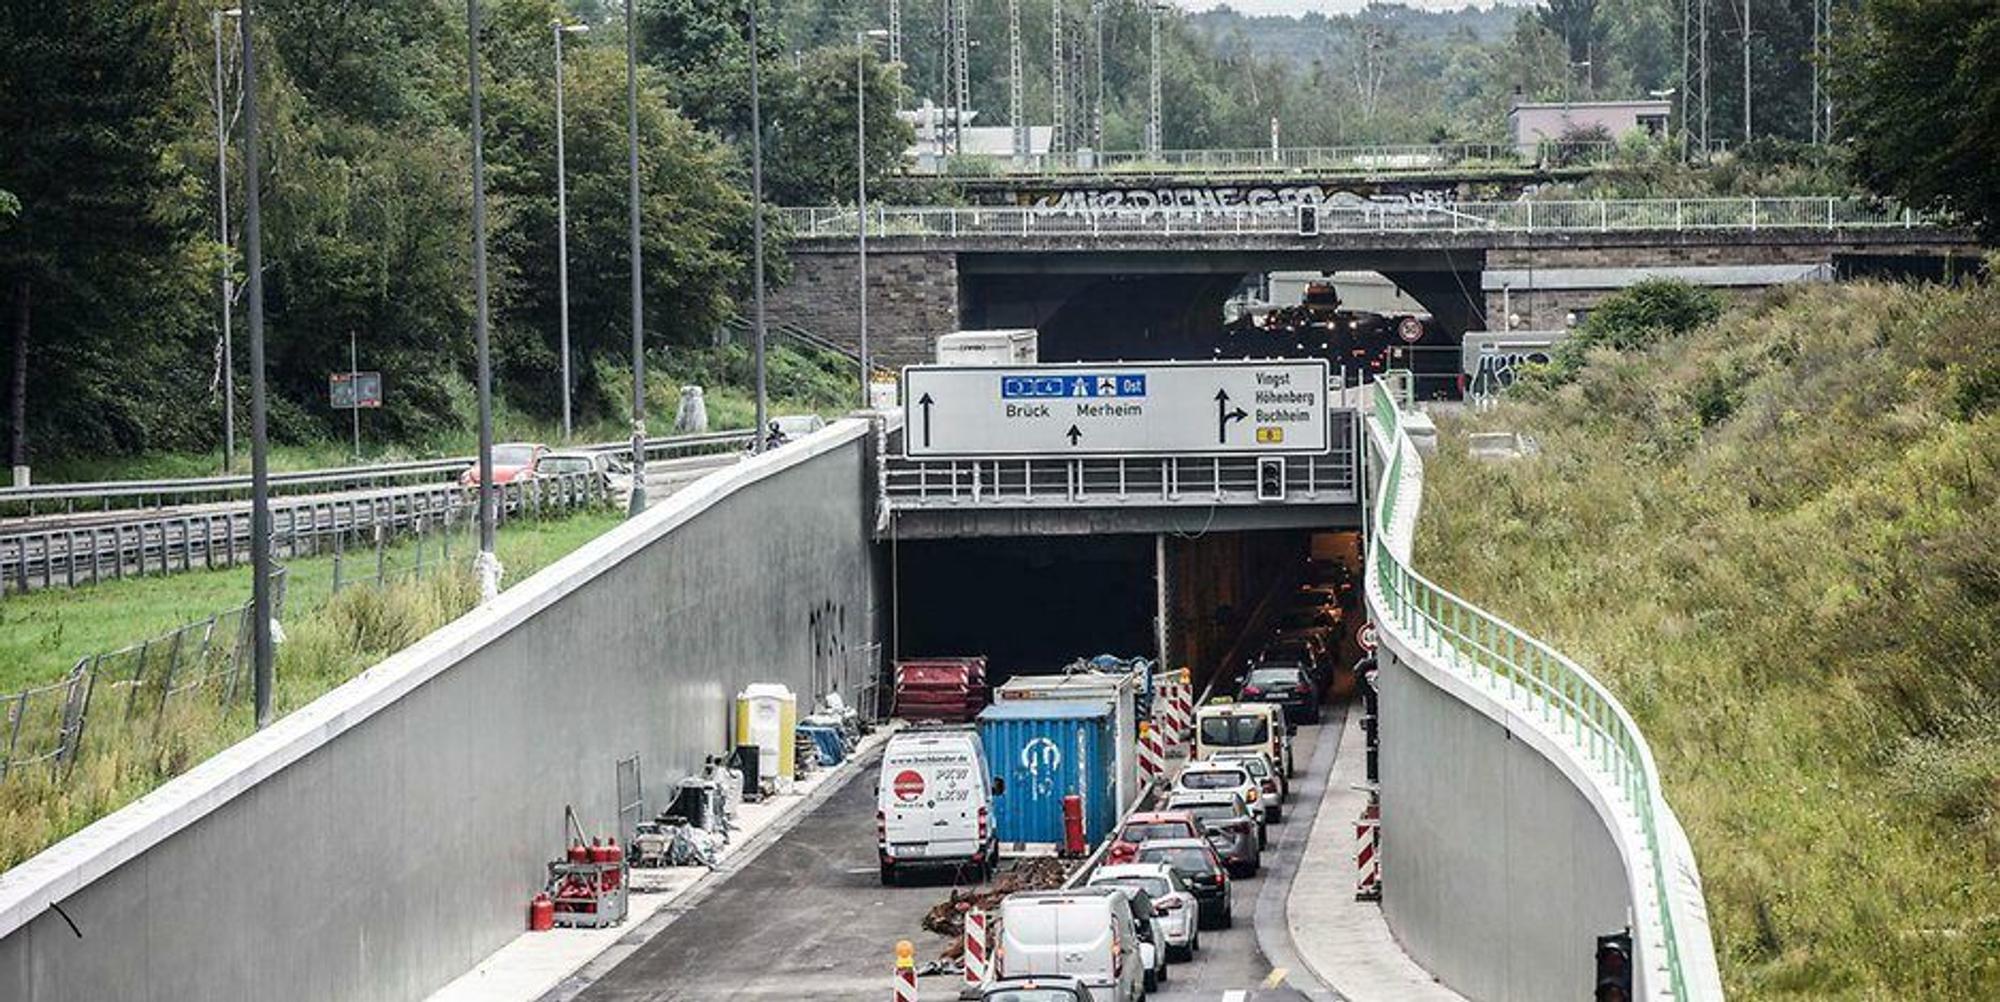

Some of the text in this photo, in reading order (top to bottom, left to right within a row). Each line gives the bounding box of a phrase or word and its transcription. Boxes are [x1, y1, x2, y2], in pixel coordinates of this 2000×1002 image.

[1123, 379, 1142, 393] Ost
[1256, 372, 1290, 388] Vingst
[1256, 390, 1315, 406] Höhenberg
[1006, 404, 1142, 417] Brück Merheim
[1256, 409, 1310, 422] Buchheim
